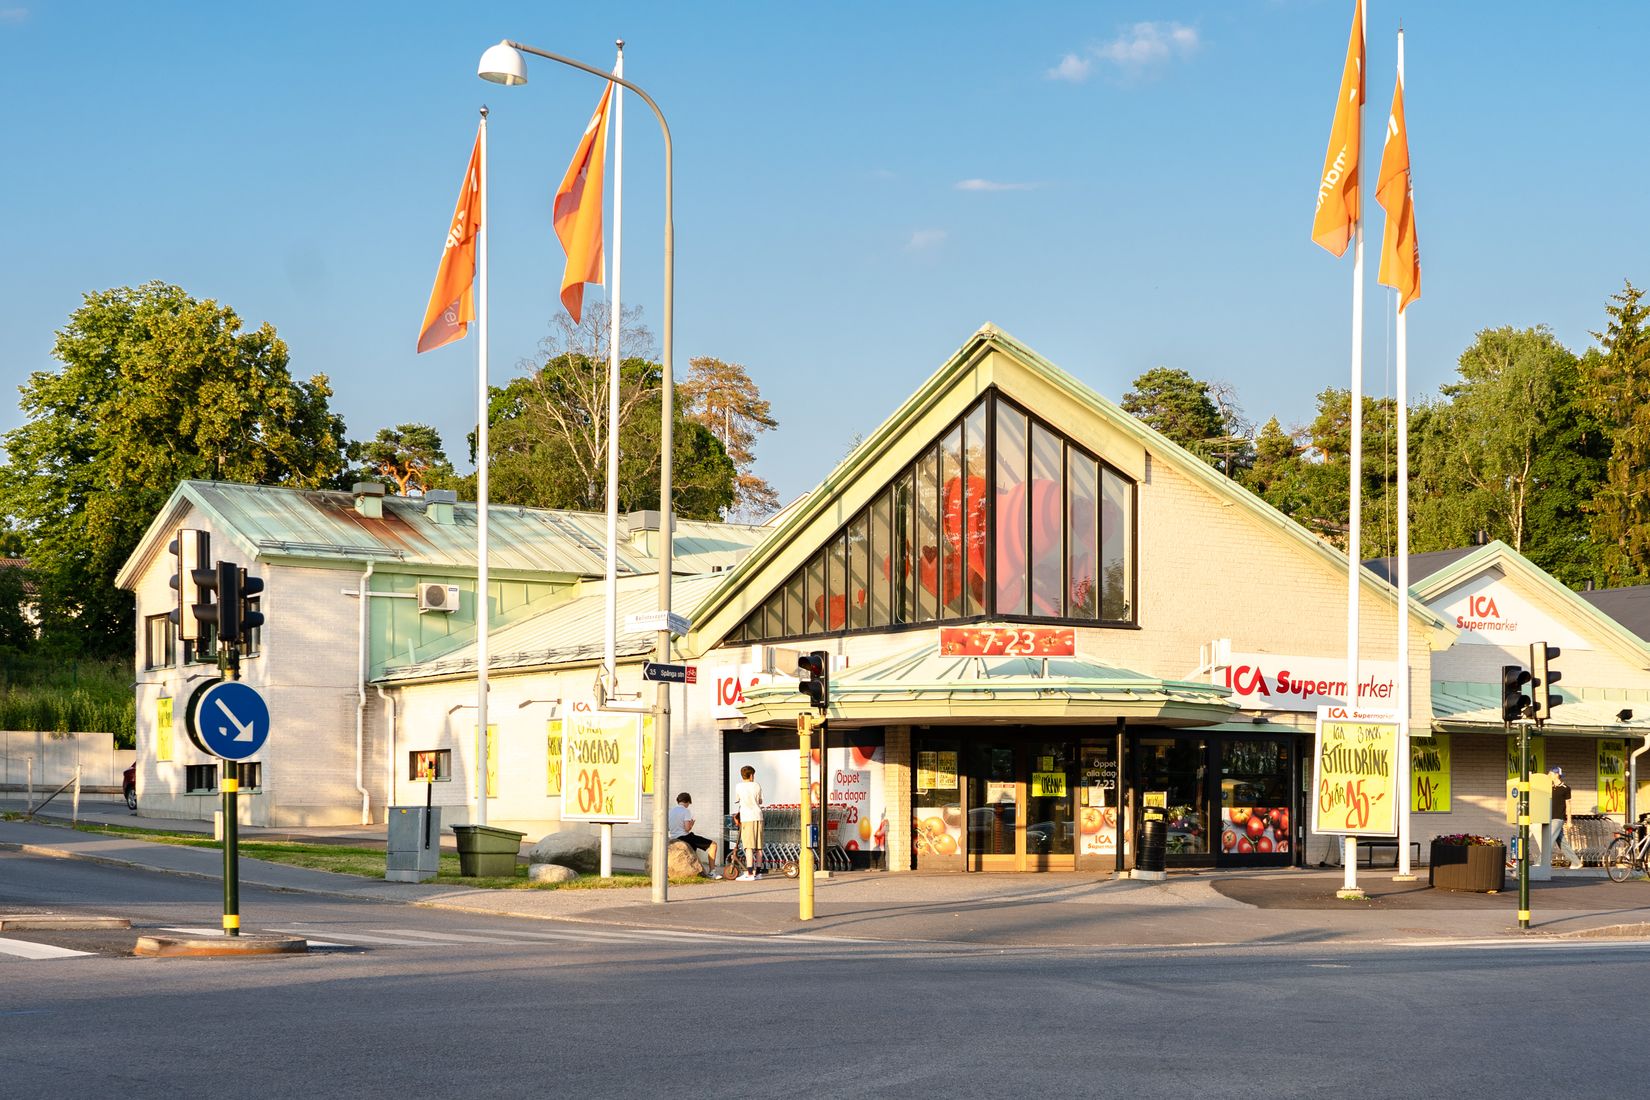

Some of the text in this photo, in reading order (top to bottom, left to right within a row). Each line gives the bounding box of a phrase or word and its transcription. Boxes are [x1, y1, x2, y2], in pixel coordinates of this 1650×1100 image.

[1470, 595, 1500, 618] ICA
[1456, 616, 1518, 632] Supermarket
[980, 630, 1036, 654] 7-23
[1225, 665, 1271, 696] ICA
[572, 701, 591, 712] ICA
[1328, 707, 1394, 719] ICA Supermarket
[1093, 760, 1117, 770] Öppet
[1321, 742, 1388, 777] STILLDRINK
[836, 769, 860, 786] Öppet
[1086, 769, 1117, 779] alla dag
[1094, 779, 1116, 790] 7-23
[829, 789, 867, 803] alla dagar
[1094, 834, 1113, 844] ICA
